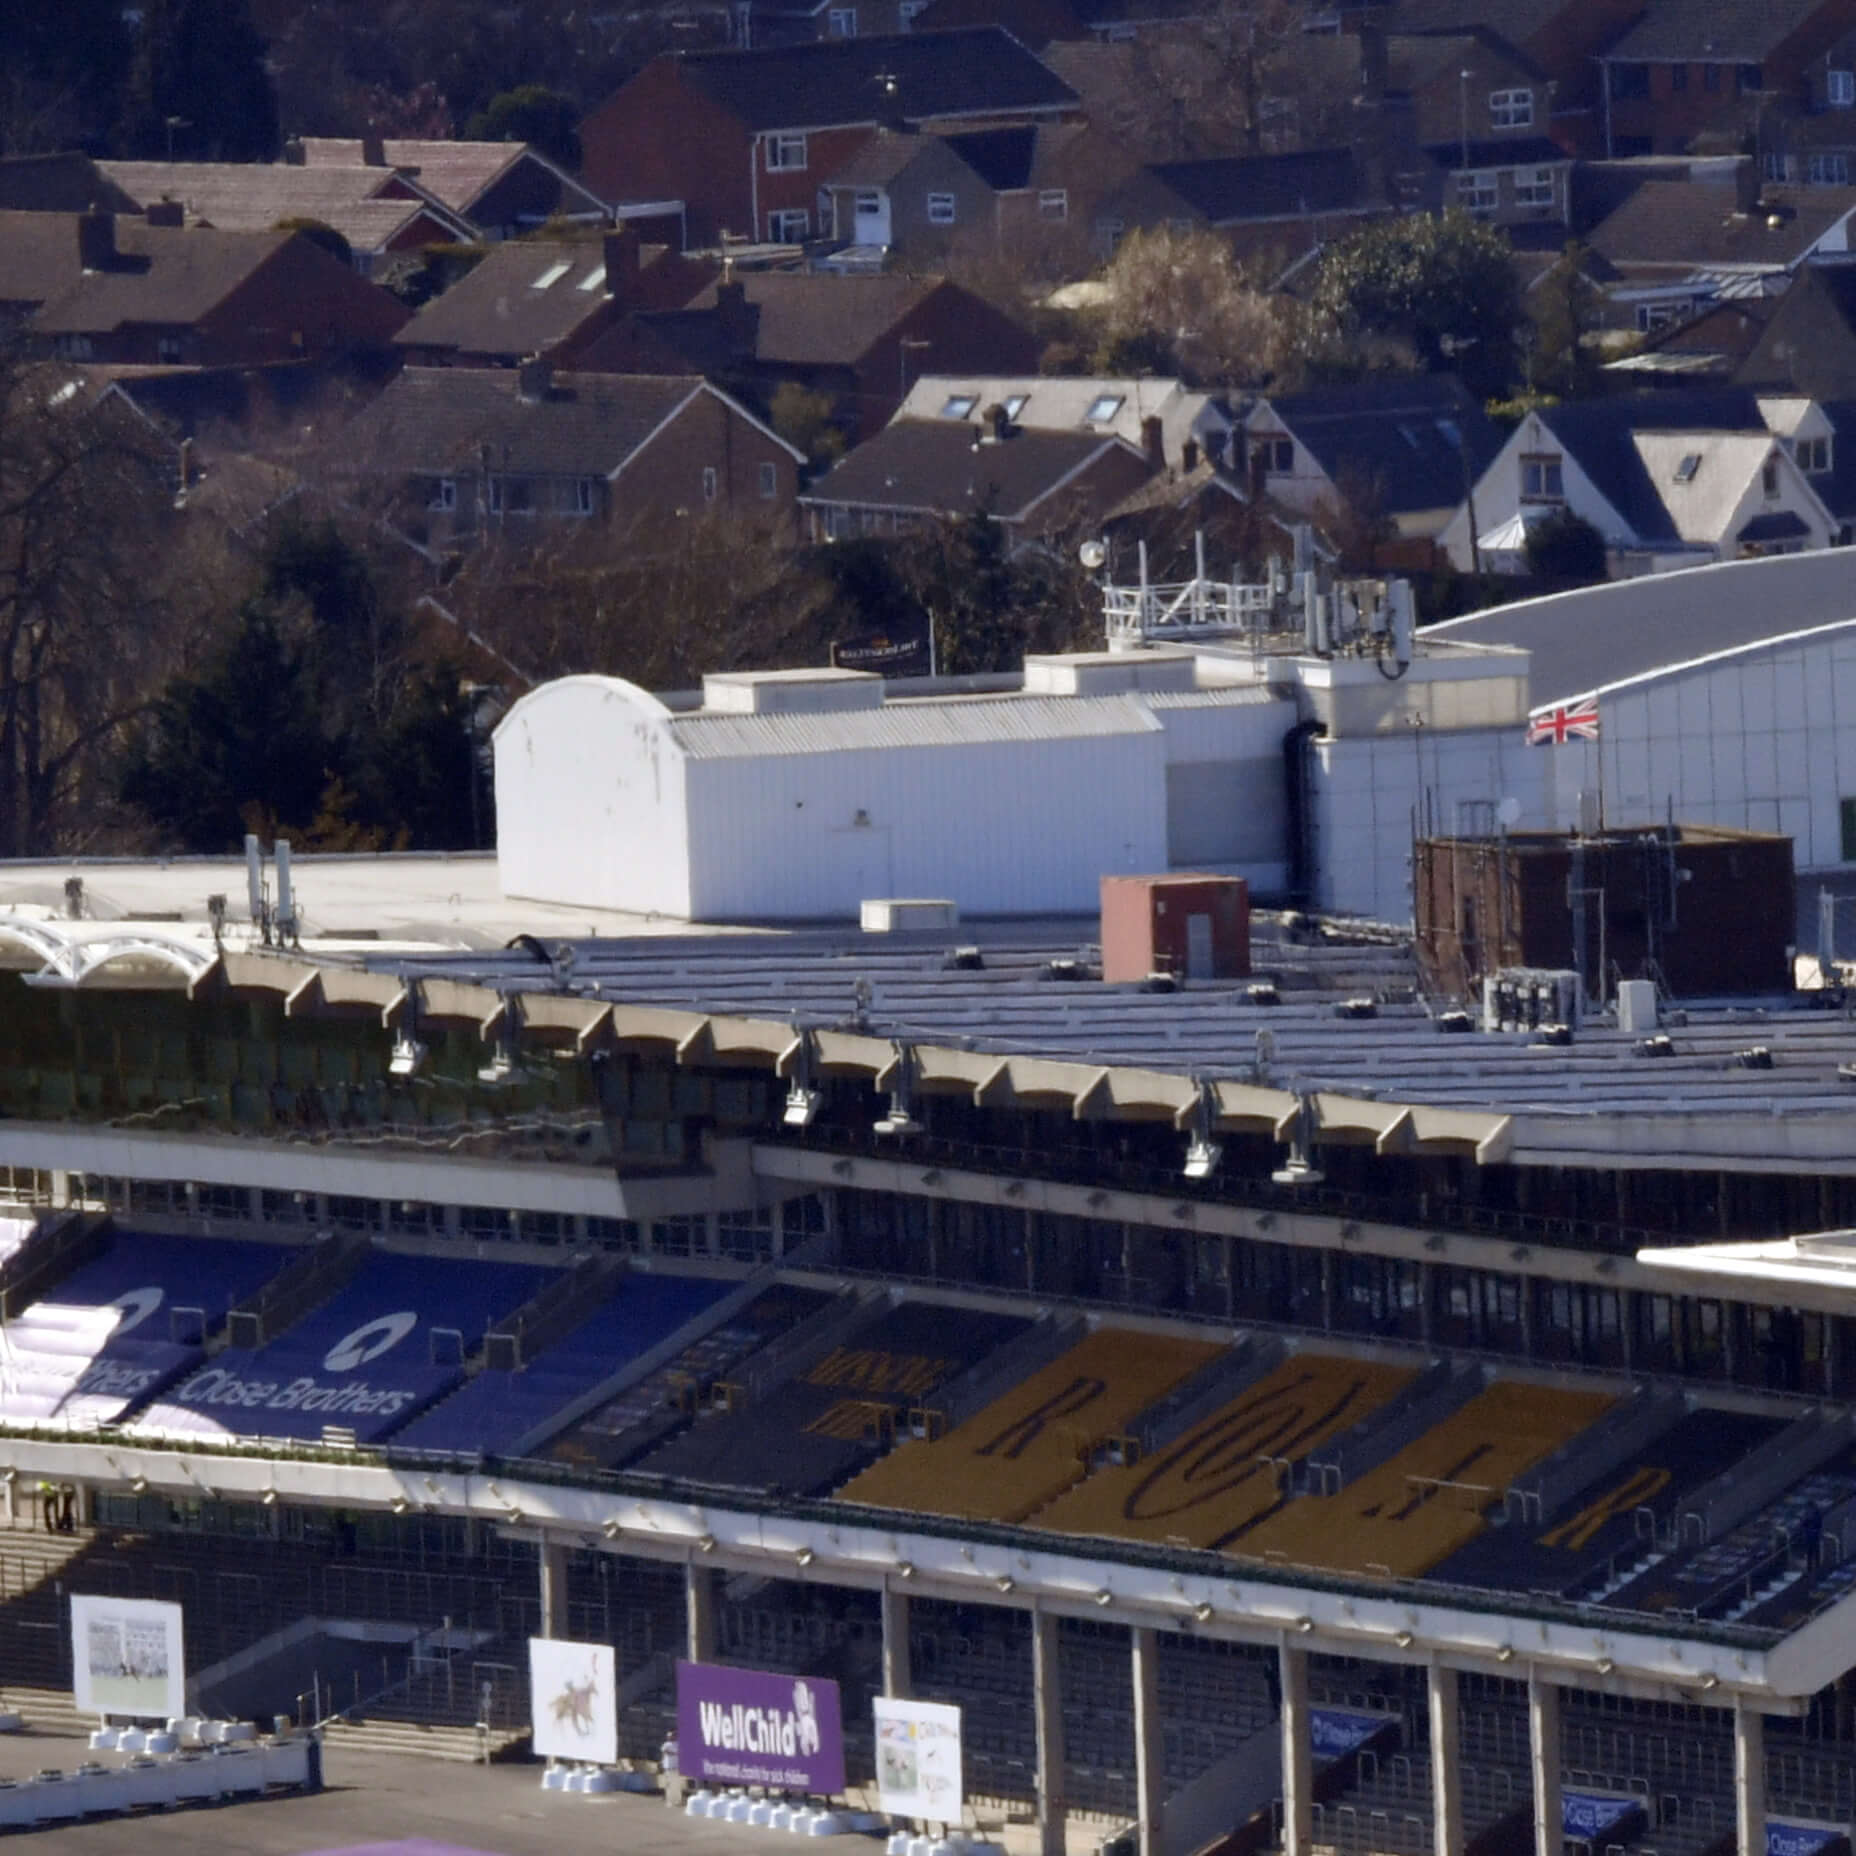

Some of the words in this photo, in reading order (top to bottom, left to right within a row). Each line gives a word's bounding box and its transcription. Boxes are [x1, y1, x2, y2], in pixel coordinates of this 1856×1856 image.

[178, 1368, 277, 1407] Close
[268, 1377, 416, 1415] Brothers
[700, 1700, 796, 1757] WellChild
